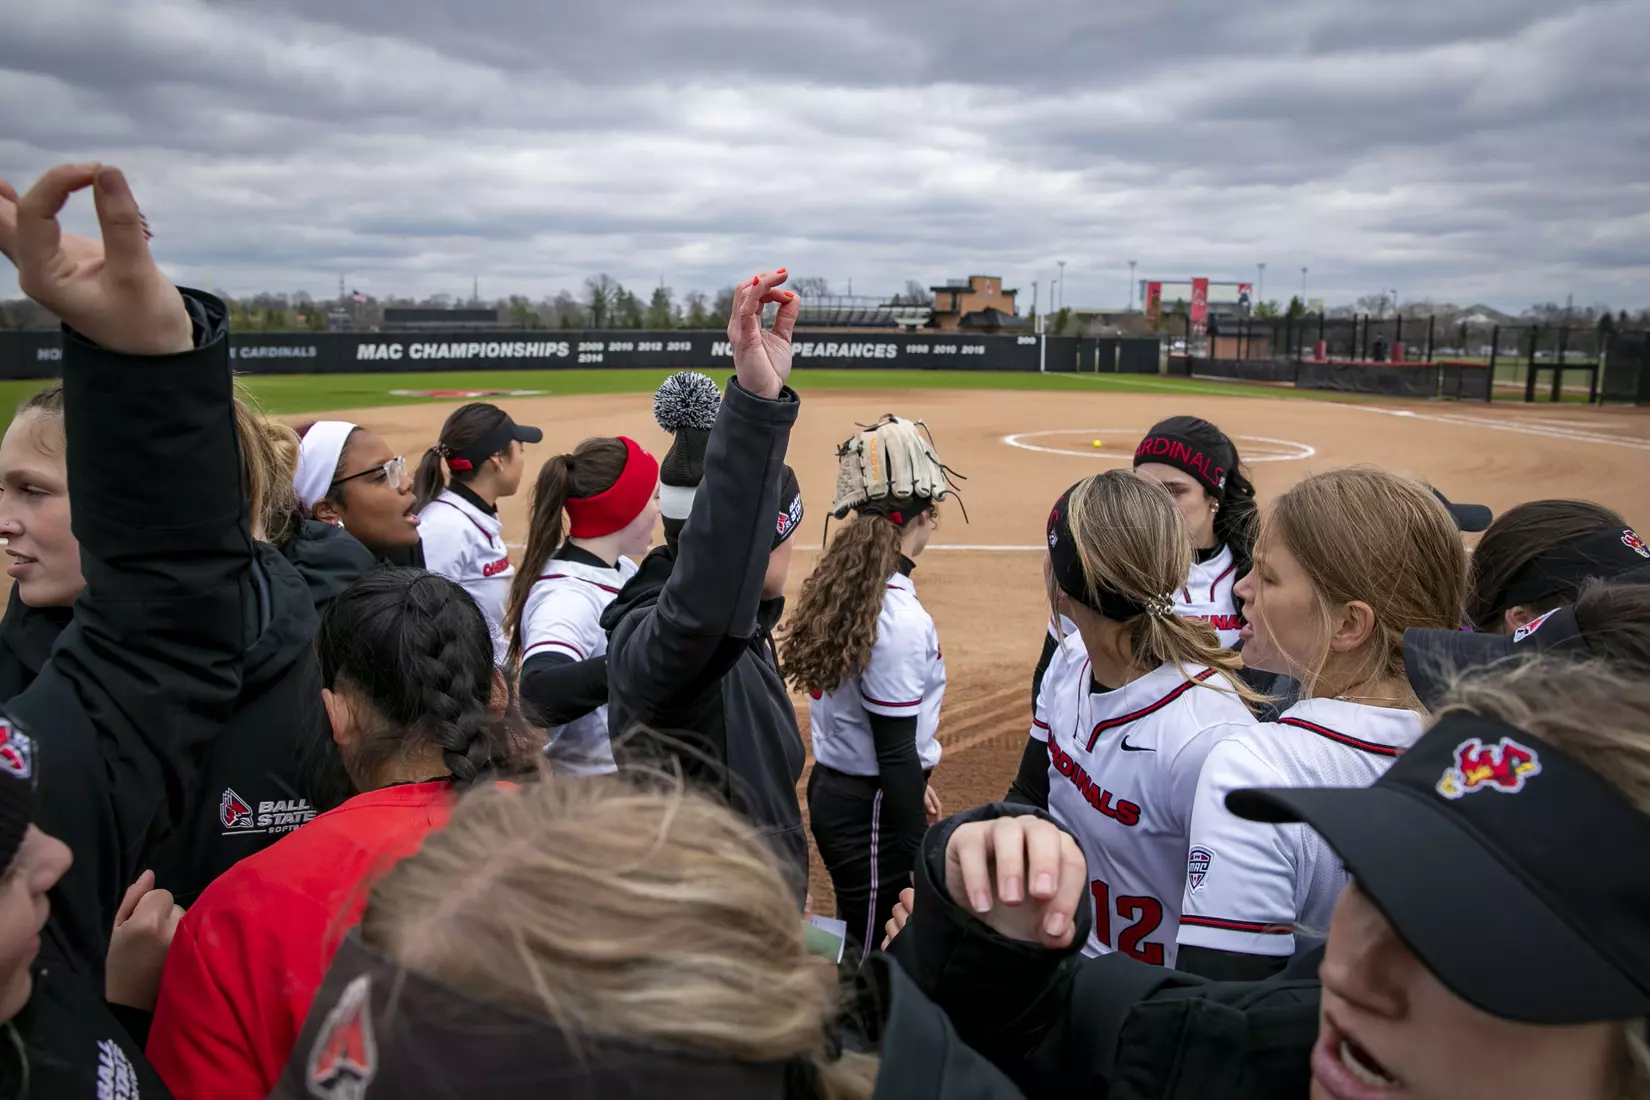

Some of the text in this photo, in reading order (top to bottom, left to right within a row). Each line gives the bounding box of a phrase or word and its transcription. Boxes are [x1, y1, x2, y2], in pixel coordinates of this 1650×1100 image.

[240, 346, 317, 358] CARDINALS
[356, 341, 570, 360] MAC CHAMPIONSHIPS
[793, 342, 898, 358] PEARANCES
[1135, 437, 1224, 487] RDINALS
[1047, 728, 1141, 826] RDINALS
[258, 799, 310, 813] BALL
[257, 810, 317, 827] STATE
[268, 823, 304, 833] SOFTB
[1091, 879, 1165, 966] 12
